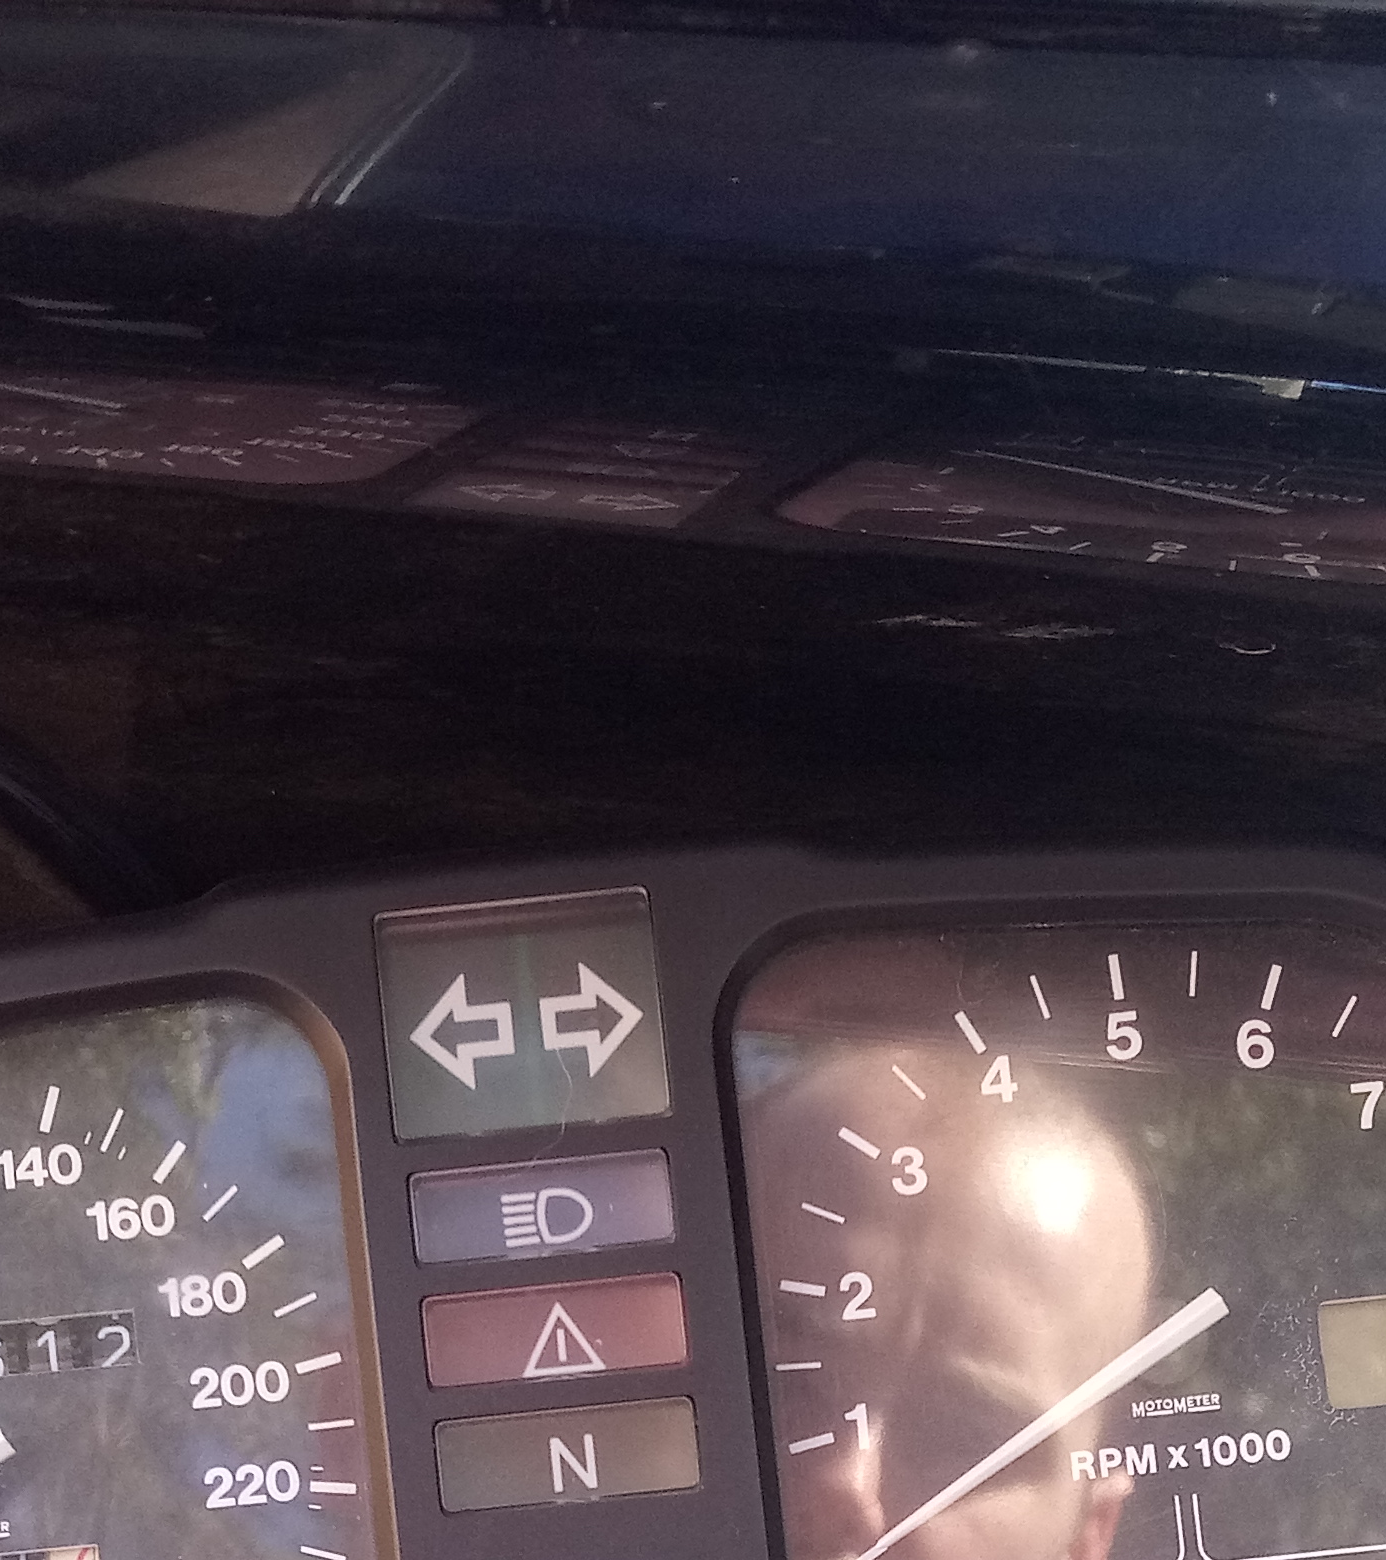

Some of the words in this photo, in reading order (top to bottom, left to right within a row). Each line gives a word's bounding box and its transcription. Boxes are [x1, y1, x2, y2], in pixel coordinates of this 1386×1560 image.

[1106, 1010, 1143, 1061] 5
[1236, 1019, 1277, 1070] 6
[980, 1054, 1018, 1104] 4
[1350, 1081, 1385, 1130] 7
[891, 1146, 929, 1197] 3
[87, 1196, 176, 1243] 160
[159, 1272, 247, 1319] 180
[839, 1272, 877, 1322] 2
[190, 1361, 290, 1409] 200
[844, 1404, 873, 1450] 1
[549, 1432, 597, 1494] N
[1070, 1447, 1159, 1482] RPM
[1194, 1428, 1292, 1468] 1000
[204, 1460, 300, 1509] 220
